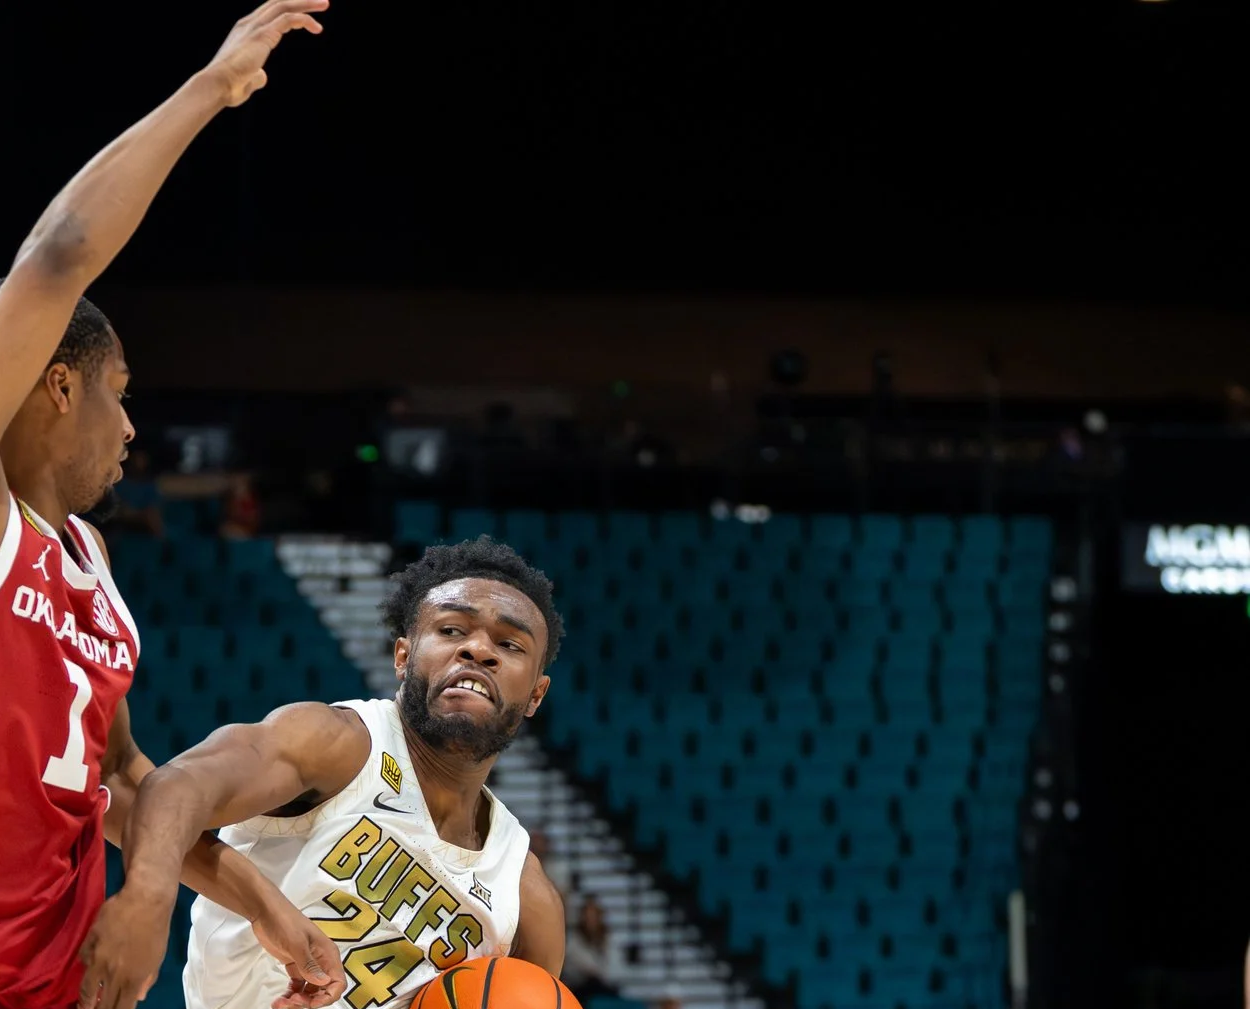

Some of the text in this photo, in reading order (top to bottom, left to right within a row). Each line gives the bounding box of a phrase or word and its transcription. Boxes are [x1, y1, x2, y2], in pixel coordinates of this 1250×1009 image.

[11, 585, 134, 671] OKAOMA
[42, 657, 92, 792] 1
[318, 815, 483, 970] BUFFS
